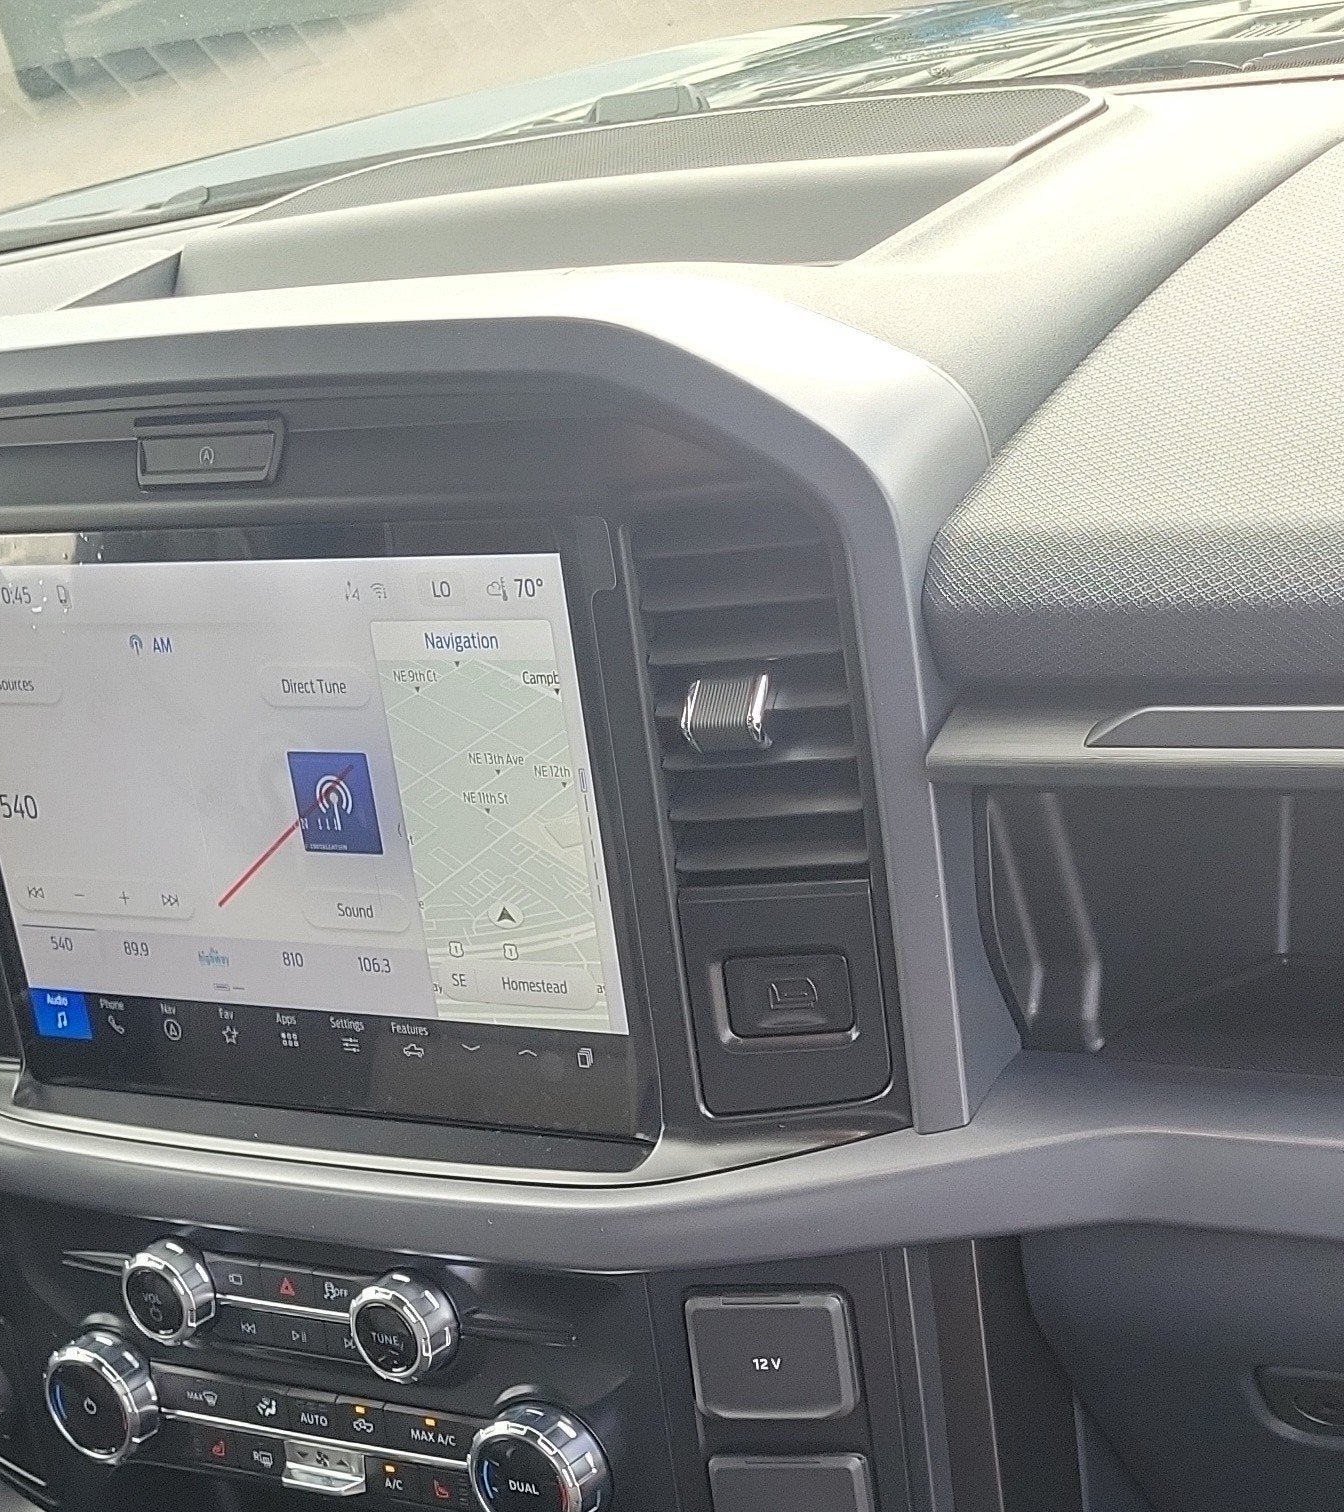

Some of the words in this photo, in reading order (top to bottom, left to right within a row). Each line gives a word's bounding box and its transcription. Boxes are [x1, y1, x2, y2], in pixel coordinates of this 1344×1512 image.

[431, 580, 451, 598] LO
[152, 637, 173, 654] AM
[424, 632, 499, 653] Navigation
[393, 670, 407, 683] NE
[408, 670, 426, 683] 9th
[426, 671, 438, 683] Ct
[281, 678, 315, 694] Direct
[317, 680, 347, 695] Tune
[468, 752, 482, 765] NE
[484, 753, 504, 765] 13th
[506, 754, 525, 766] Ave
[534, 765, 548, 778] NE
[549, 766, 572, 778] 12th
[463, 791, 477, 804] NE
[497, 793, 510, 805] St
[337, 903, 374, 919] Sound
[50, 937, 73, 951] 540
[124, 941, 149, 956] 89.9
[282, 952, 304, 967] 810
[358, 957, 391, 973] 106.3
[451, 973, 467, 987] SE
[502, 976, 567, 994] Homestead
[100, 999, 124, 1011] Phone
[160, 1002, 176, 1015] Nav
[276, 1013, 296, 1027] Apps
[329, 1017, 364, 1032] Settings
[391, 1021, 429, 1037] Features
[371, 1331, 400, 1346] TUNE
[753, 1358, 769, 1371] 12
[770, 1358, 782, 1371] V
[300, 1412, 328, 1427] AUTO
[411, 1428, 436, 1443] MAX
[436, 1432, 456, 1447] A/C
[385, 1477, 403, 1491] A/C
[509, 1479, 540, 1496] DUAL
